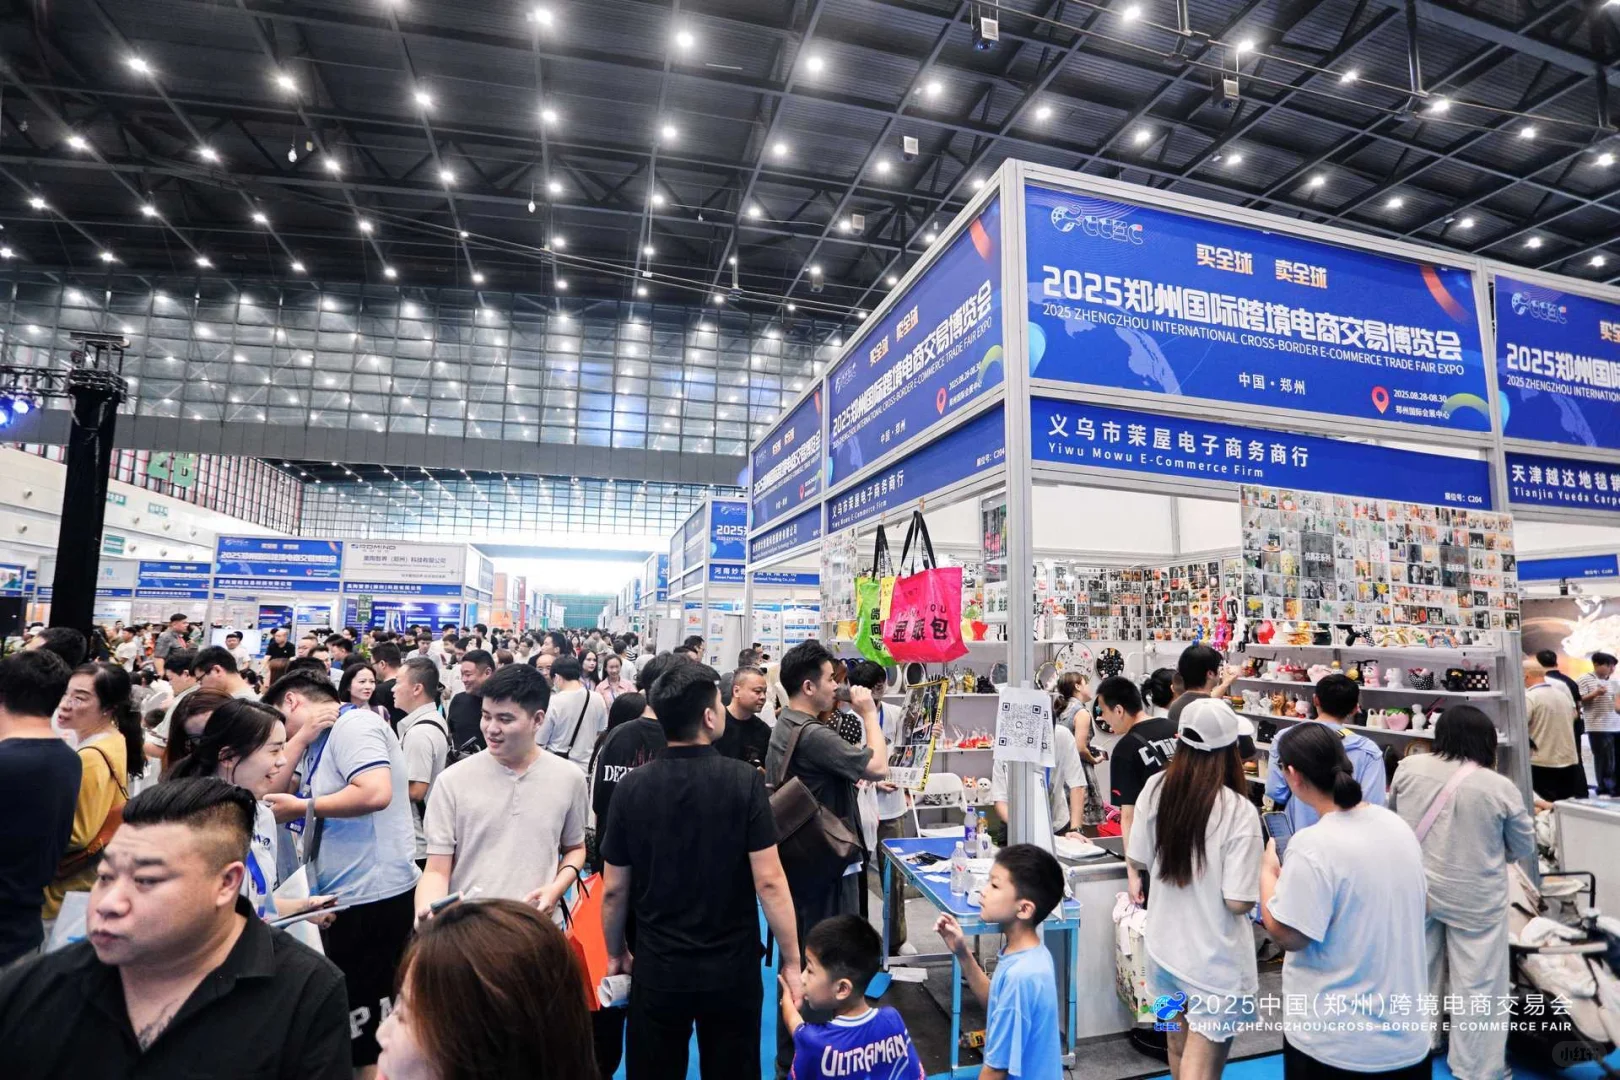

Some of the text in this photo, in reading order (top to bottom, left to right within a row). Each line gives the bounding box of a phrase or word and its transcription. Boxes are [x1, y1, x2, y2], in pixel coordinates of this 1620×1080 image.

[1196, 243, 1328, 290] 买全球 卖全球
[1042, 264, 1463, 362] 2025郑州国际跨境电商交易博览会
[832, 279, 992, 437] 2025郑州国际跨境电商交易博览会
[913, 356, 945, 388] E-COMMERCE
[945, 341, 963, 363] TRADE
[963, 331, 977, 349] FAIR
[976, 316, 992, 339] EXPO
[1043, 303, 1464, 376] 2025 ZHENGZHOU INTERNATIONAL CROSS-BORDER E-COMMERCE TRADE FAIR EXPO
[1393, 389, 1448, 403] 2025.08.28-08.30
[1506, 374, 1525, 388] 2025
[1526, 376, 1572, 395] ZHENGZHOU
[1395, 405, 1450, 420] 郑州国际会展中心
[1047, 413, 1309, 468] 义乌市茉屋电子商务商行
[1048, 442, 1264, 478] Yiwu Mowu E-Commerce Firm
[850, 504, 875, 522] E-Commerce
[874, 499, 887, 512] Firm
[1514, 486, 1620, 506] Tianjin Yueda Carp
[820, 1032, 909, 1077] ULTRAMAN
